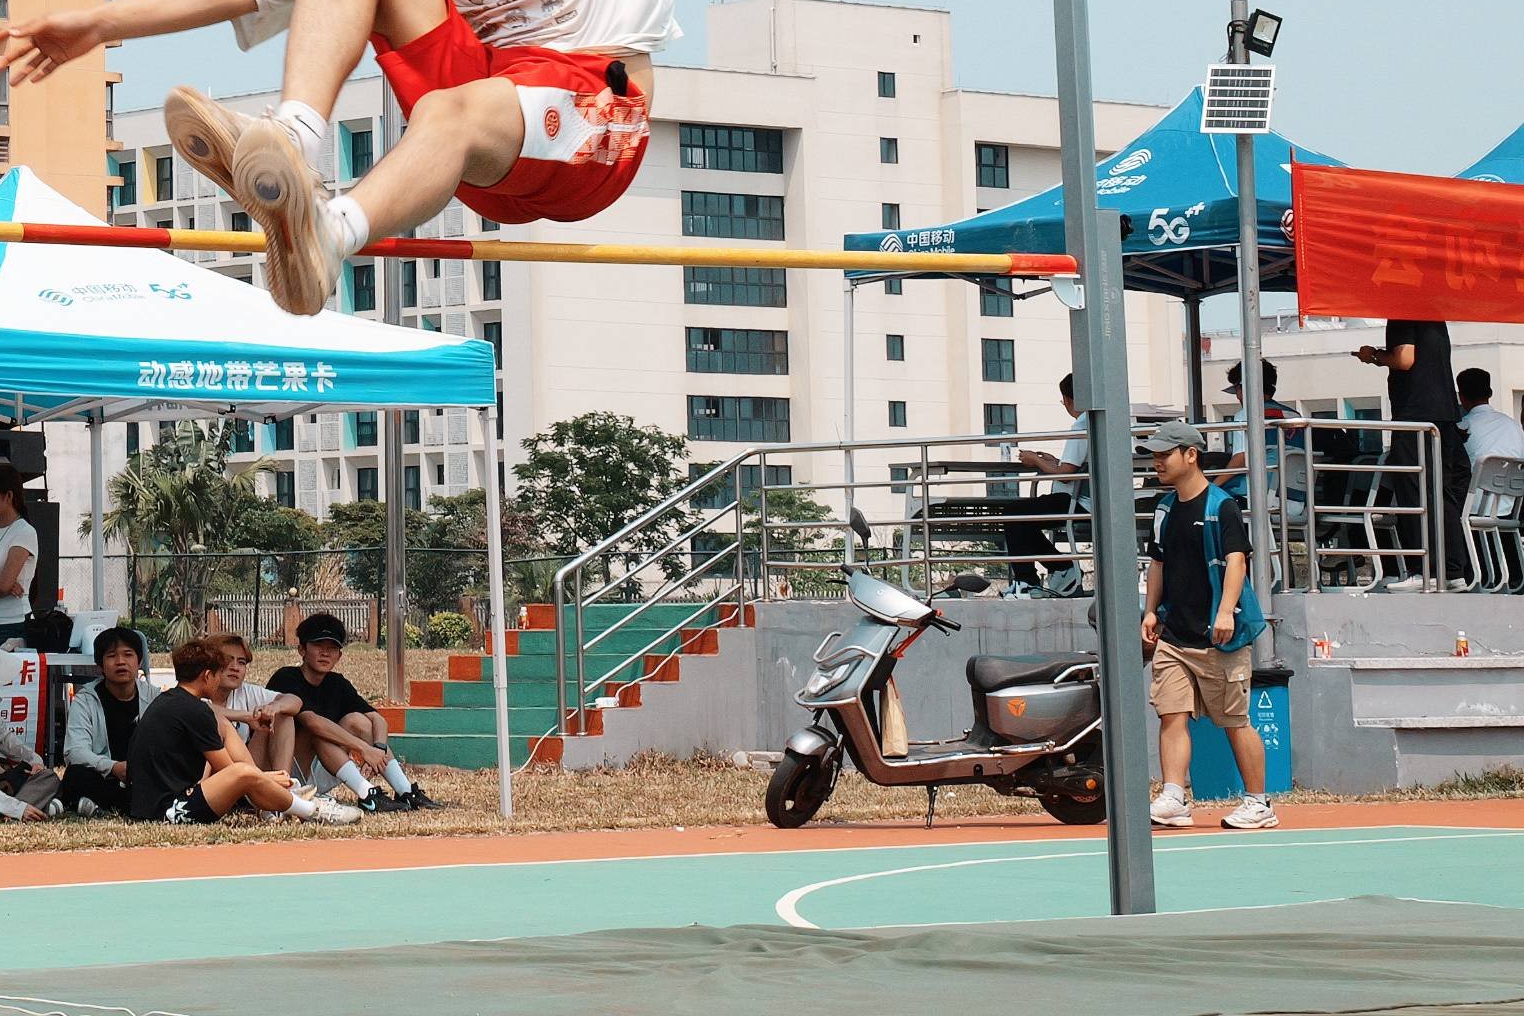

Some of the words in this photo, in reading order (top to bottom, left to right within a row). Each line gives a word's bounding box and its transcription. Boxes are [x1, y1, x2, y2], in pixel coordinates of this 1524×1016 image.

[906, 229, 955, 247] 中国移动
[137, 360, 338, 394] 动感地带芒果卡
